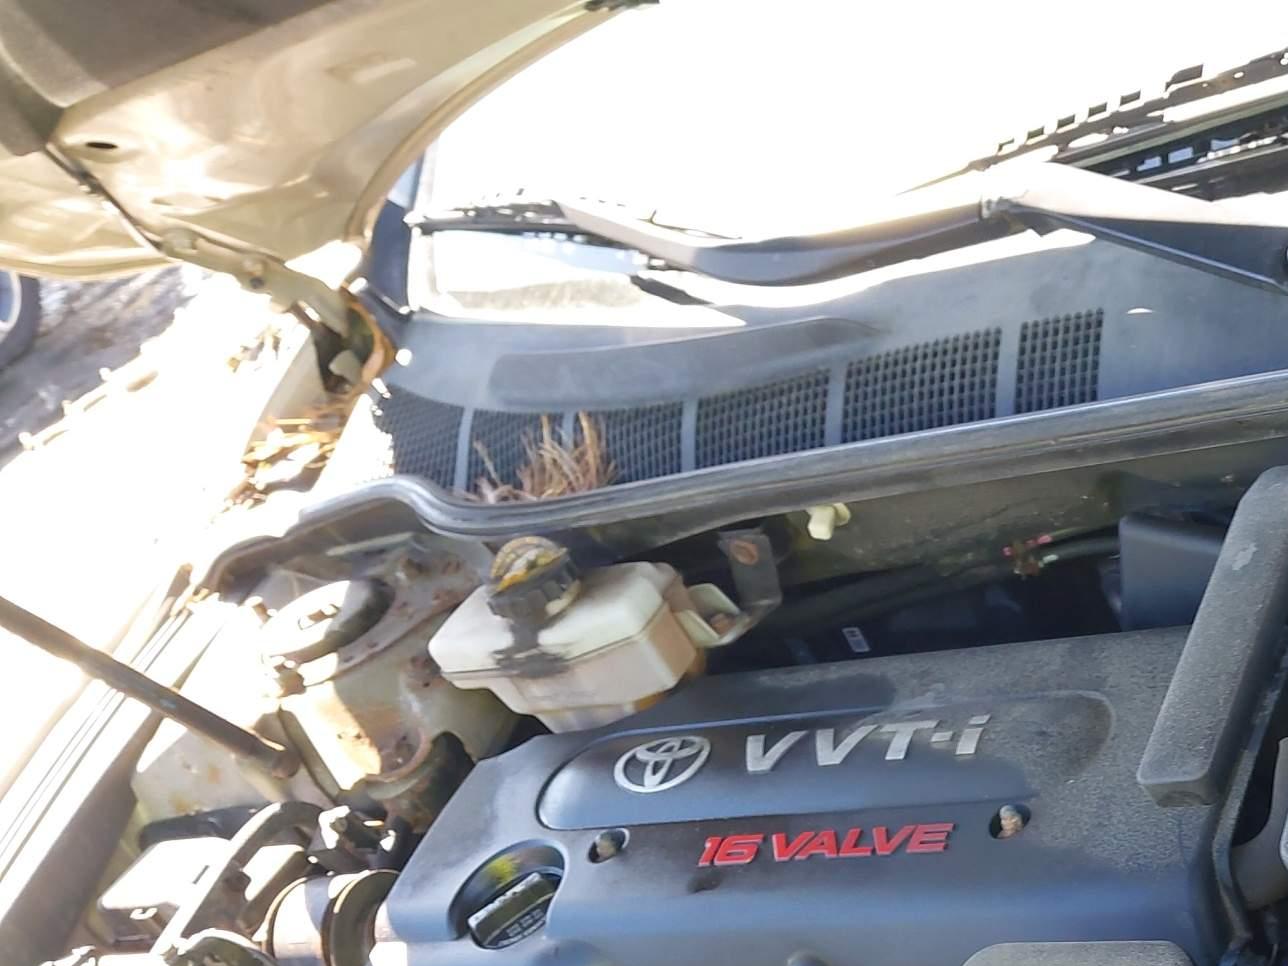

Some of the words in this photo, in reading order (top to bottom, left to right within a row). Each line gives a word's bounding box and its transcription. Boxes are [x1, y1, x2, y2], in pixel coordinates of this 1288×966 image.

[745, 714, 991, 773] VVT-i
[698, 833, 764, 868] 16
[771, 823, 956, 862] VALVE
